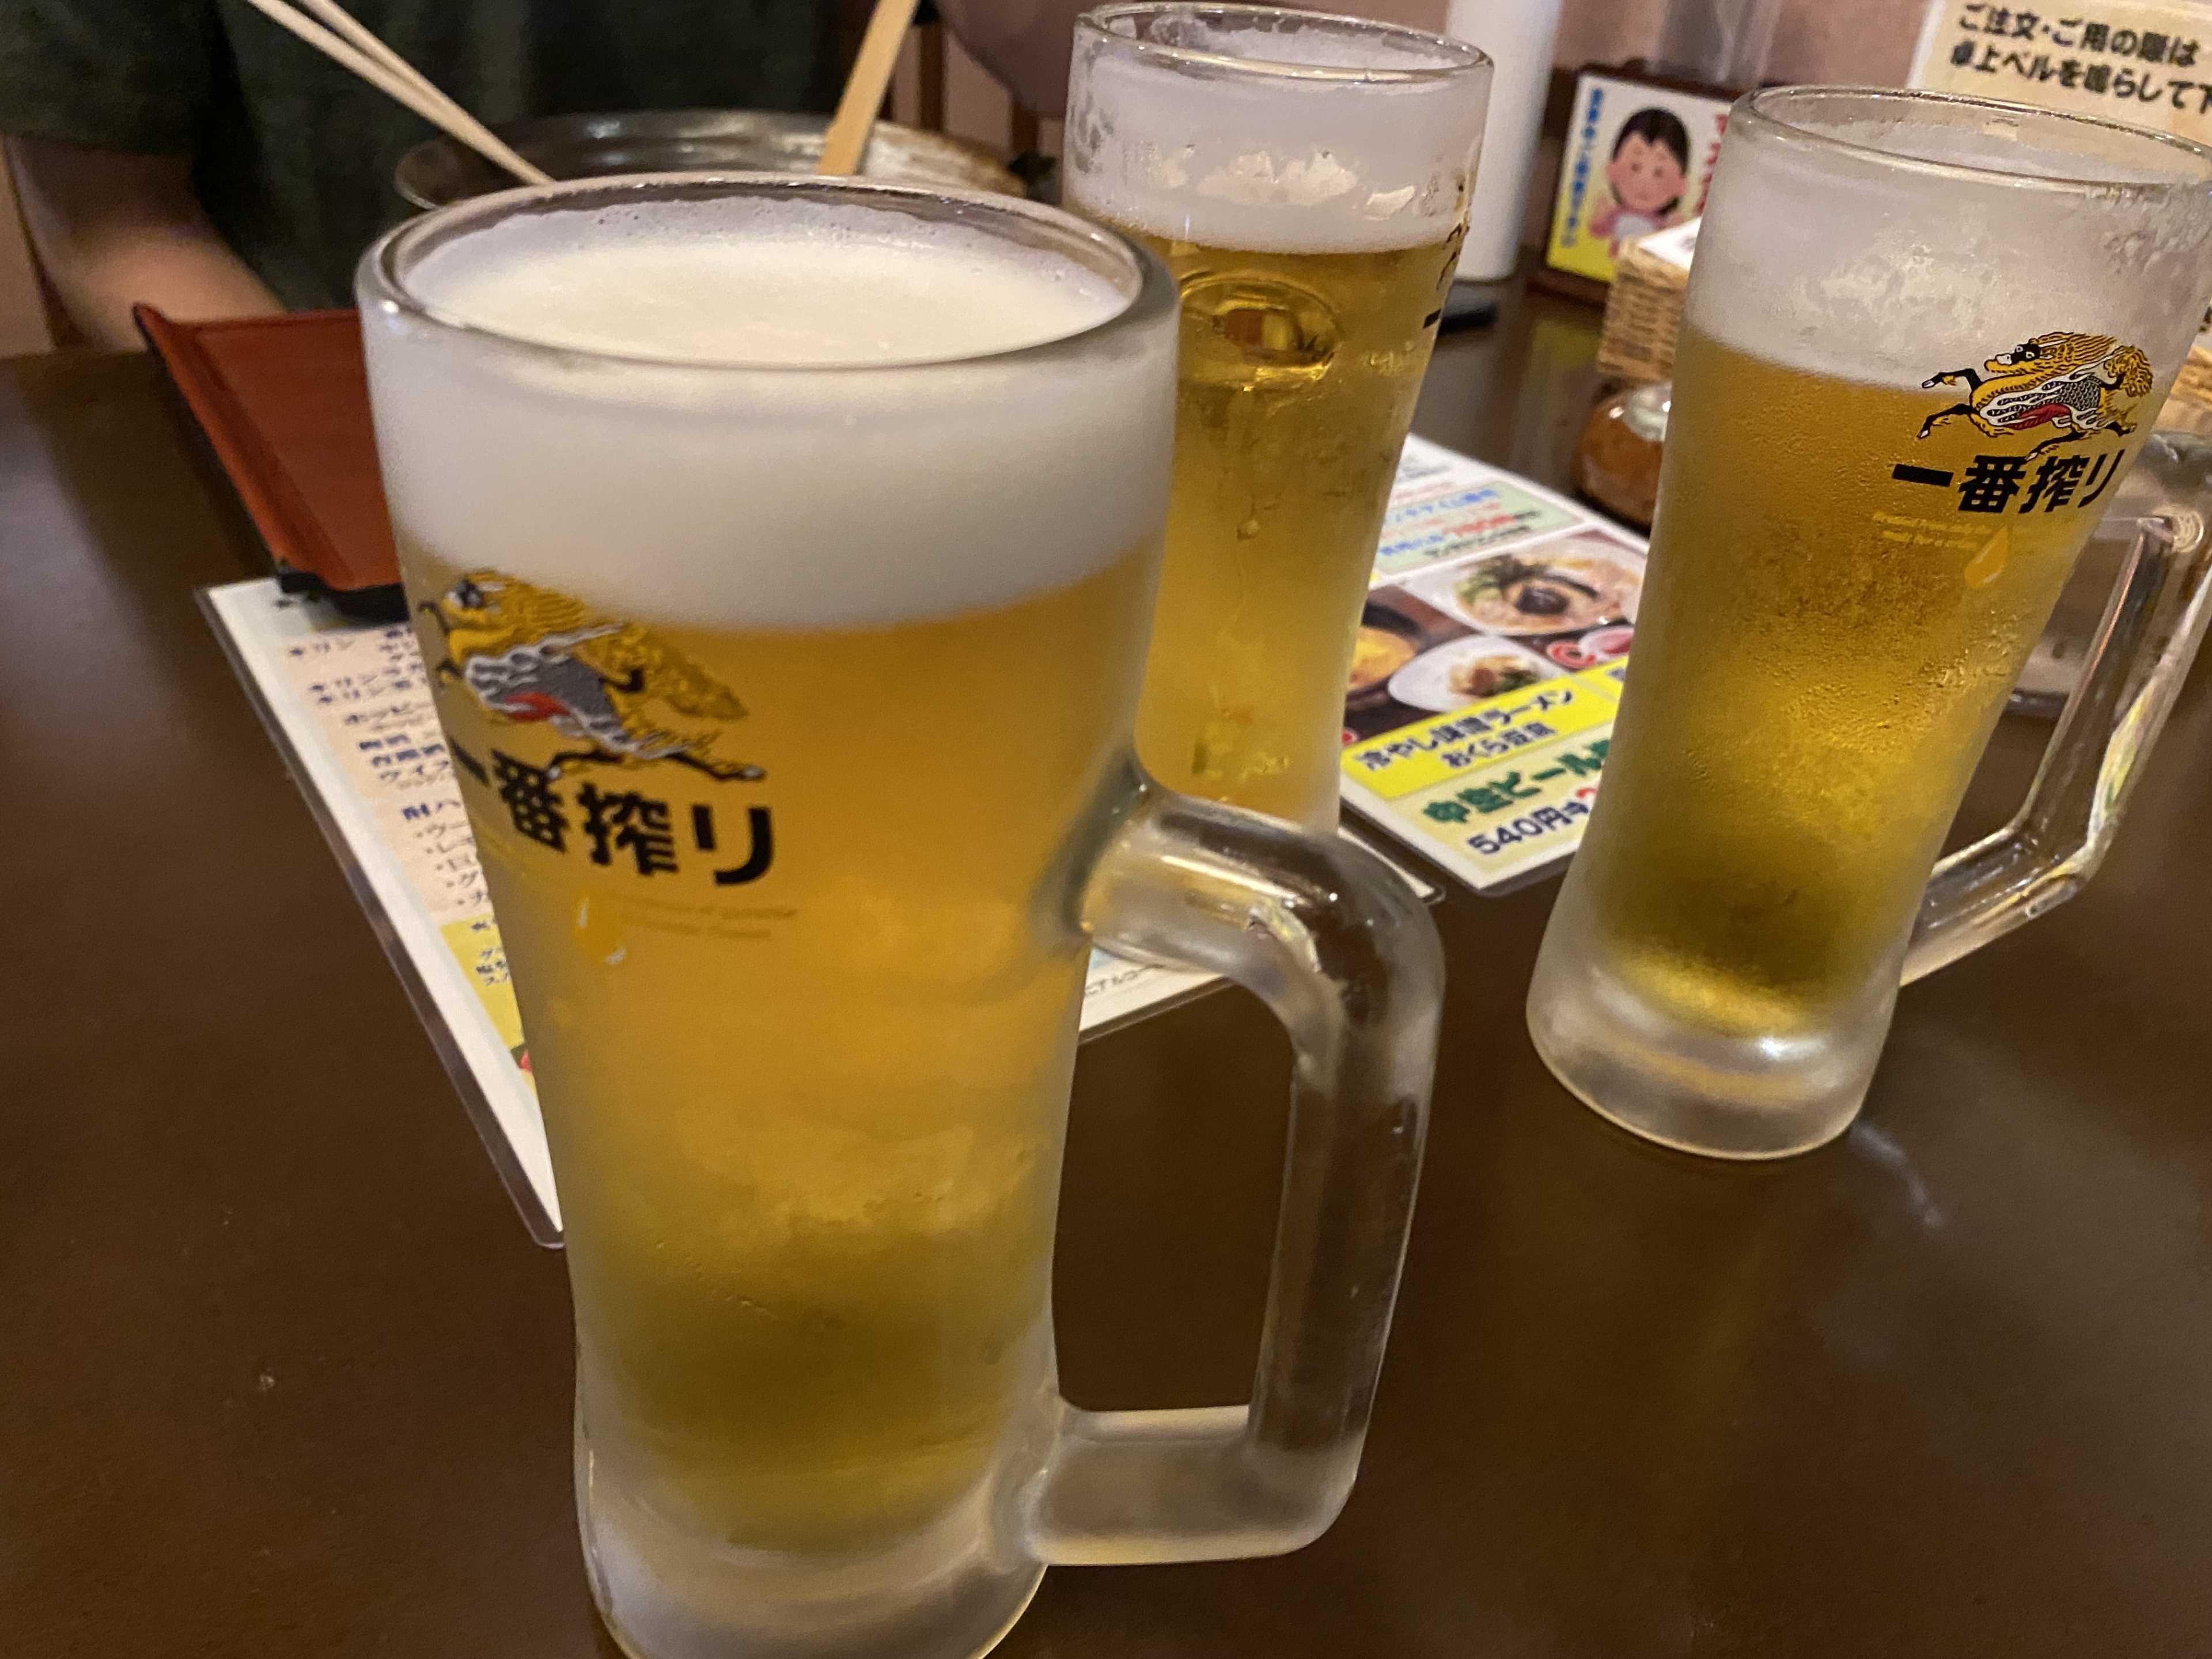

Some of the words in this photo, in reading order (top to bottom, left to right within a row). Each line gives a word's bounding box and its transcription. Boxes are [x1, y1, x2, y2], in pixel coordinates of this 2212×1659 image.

[1892, 449, 2126, 514] 一番搾り
[451, 742, 772, 886] 一番搾り
